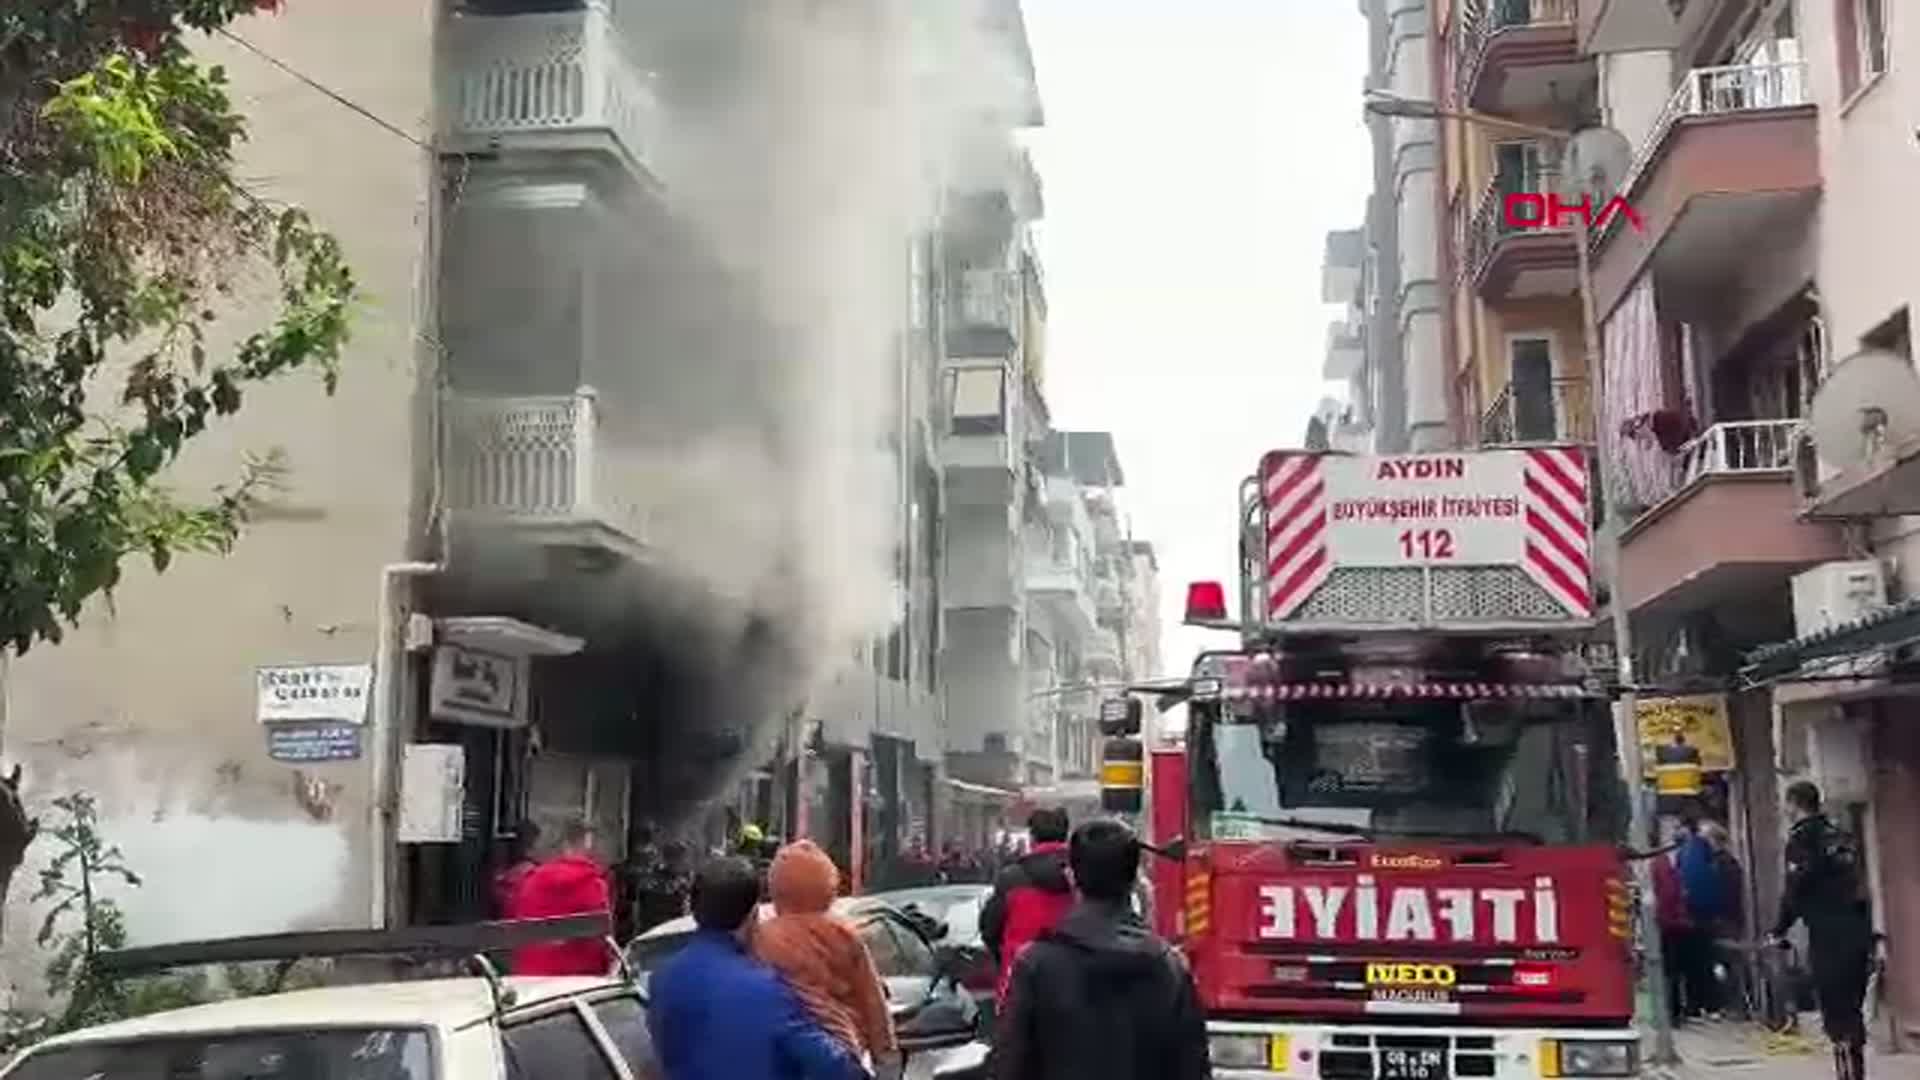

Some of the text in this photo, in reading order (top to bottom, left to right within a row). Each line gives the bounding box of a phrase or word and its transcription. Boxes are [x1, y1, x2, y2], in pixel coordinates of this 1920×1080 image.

[1377, 459, 1464, 479] AYDIN
[1399, 531, 1454, 559] 112
[1366, 963, 1456, 985] IVECO
